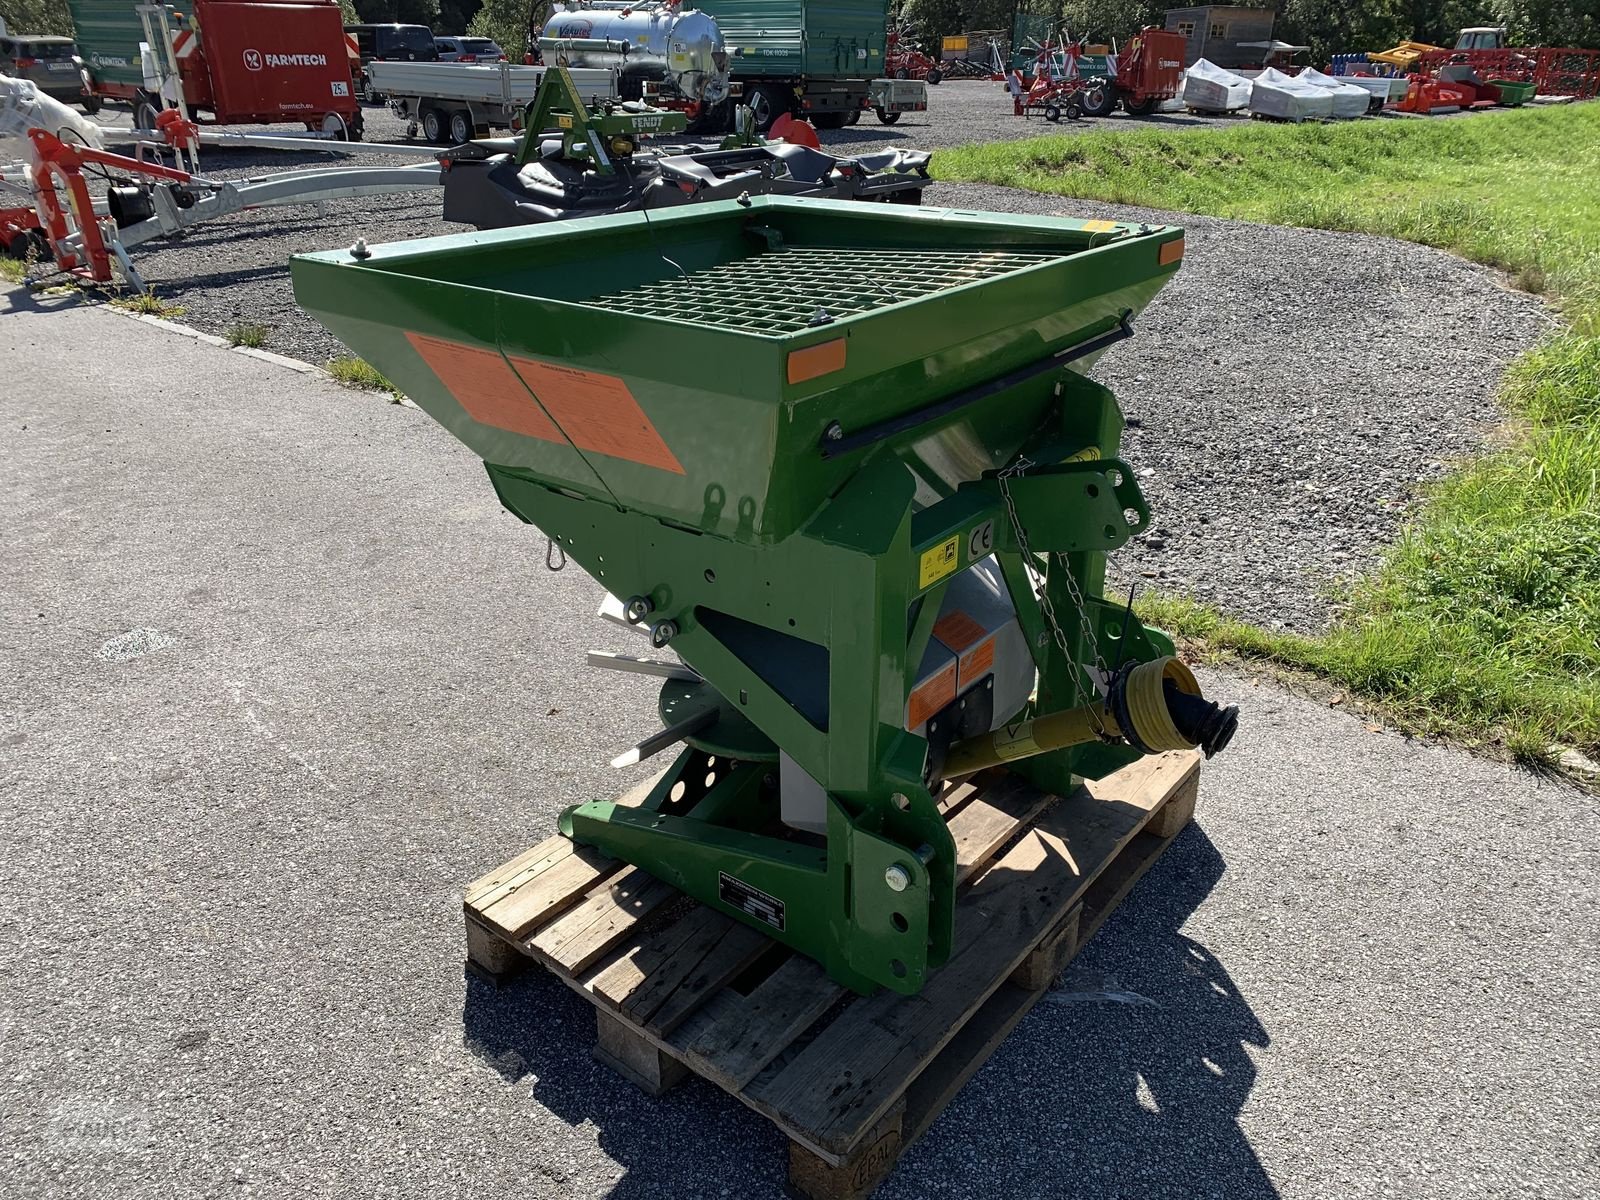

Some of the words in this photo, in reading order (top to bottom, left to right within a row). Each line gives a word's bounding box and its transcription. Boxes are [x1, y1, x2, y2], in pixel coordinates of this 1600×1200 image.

[560, 24, 591, 36] Vakutec
[265, 54, 327, 67] FARMTECH
[333, 83, 342, 95] 25
[278, 102, 314, 110] farmtech.eu
[631, 116, 664, 128] FENDT
[859, 1142, 888, 1185] EPAL
